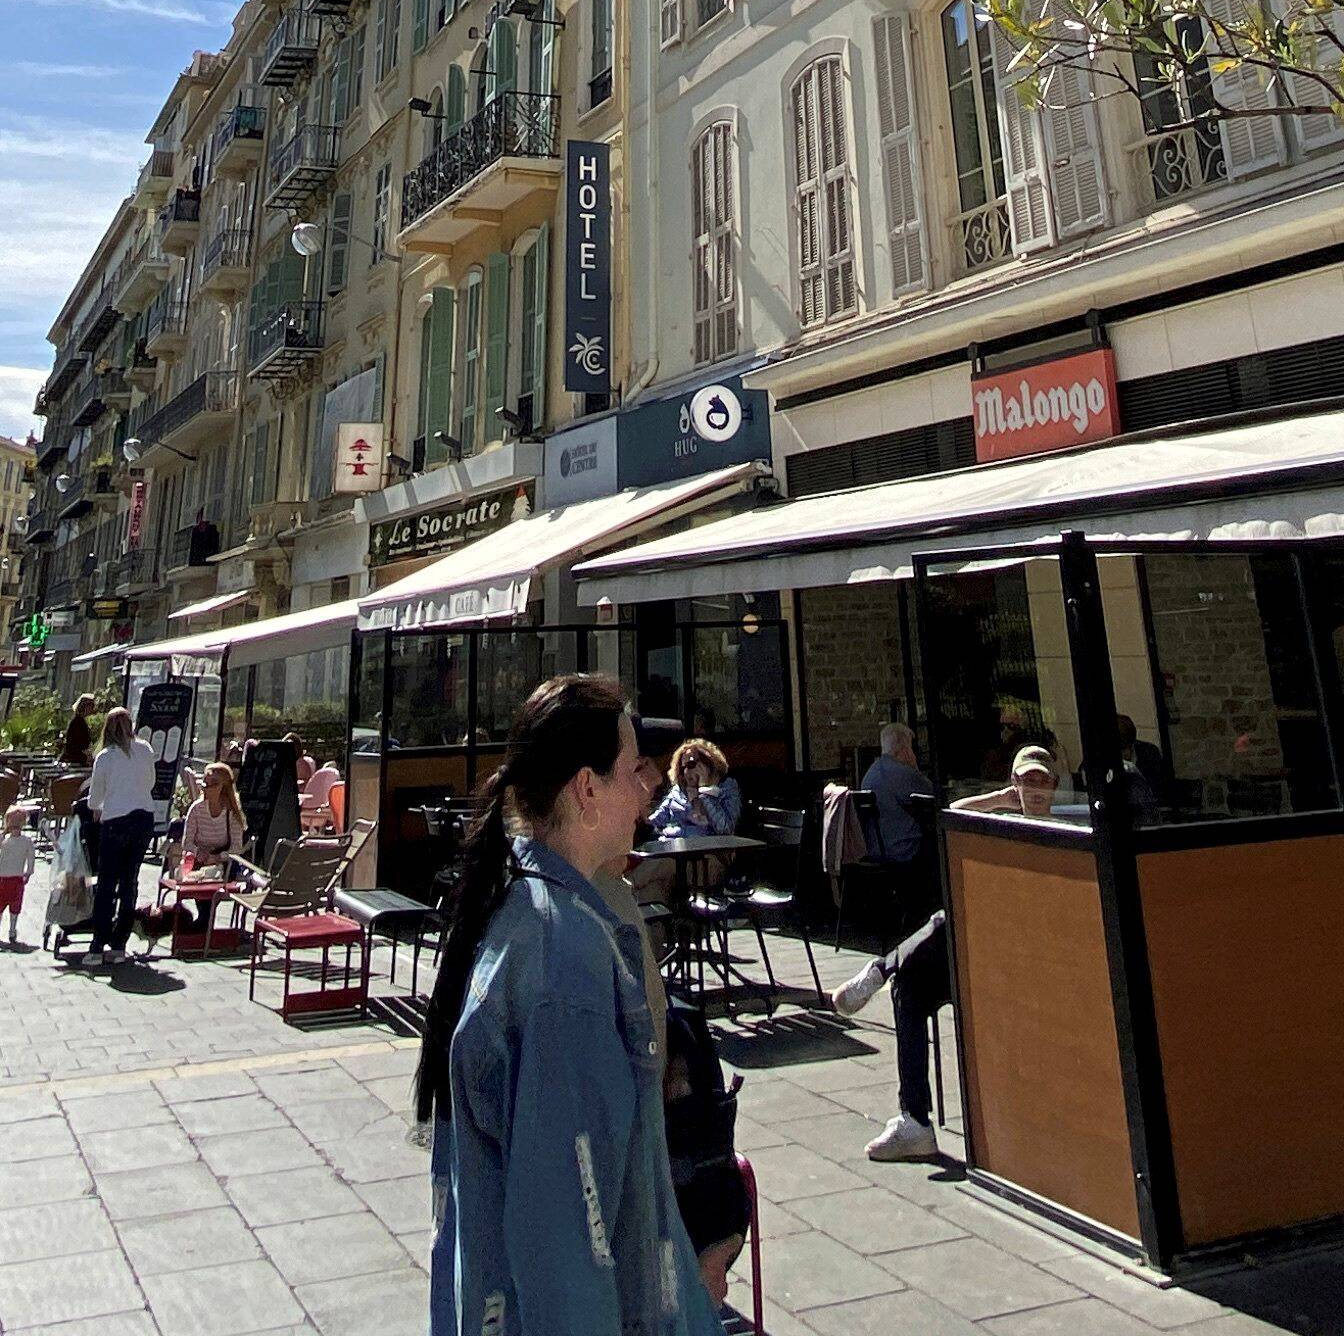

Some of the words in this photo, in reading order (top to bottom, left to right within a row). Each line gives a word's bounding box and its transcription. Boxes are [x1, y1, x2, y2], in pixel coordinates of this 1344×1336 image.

[579, 155, 597, 300] HOTEL
[975, 377, 1105, 438] Malongo
[674, 436, 698, 457] HUG
[389, 519, 411, 546] Le
[416, 500, 501, 538] Socrate
